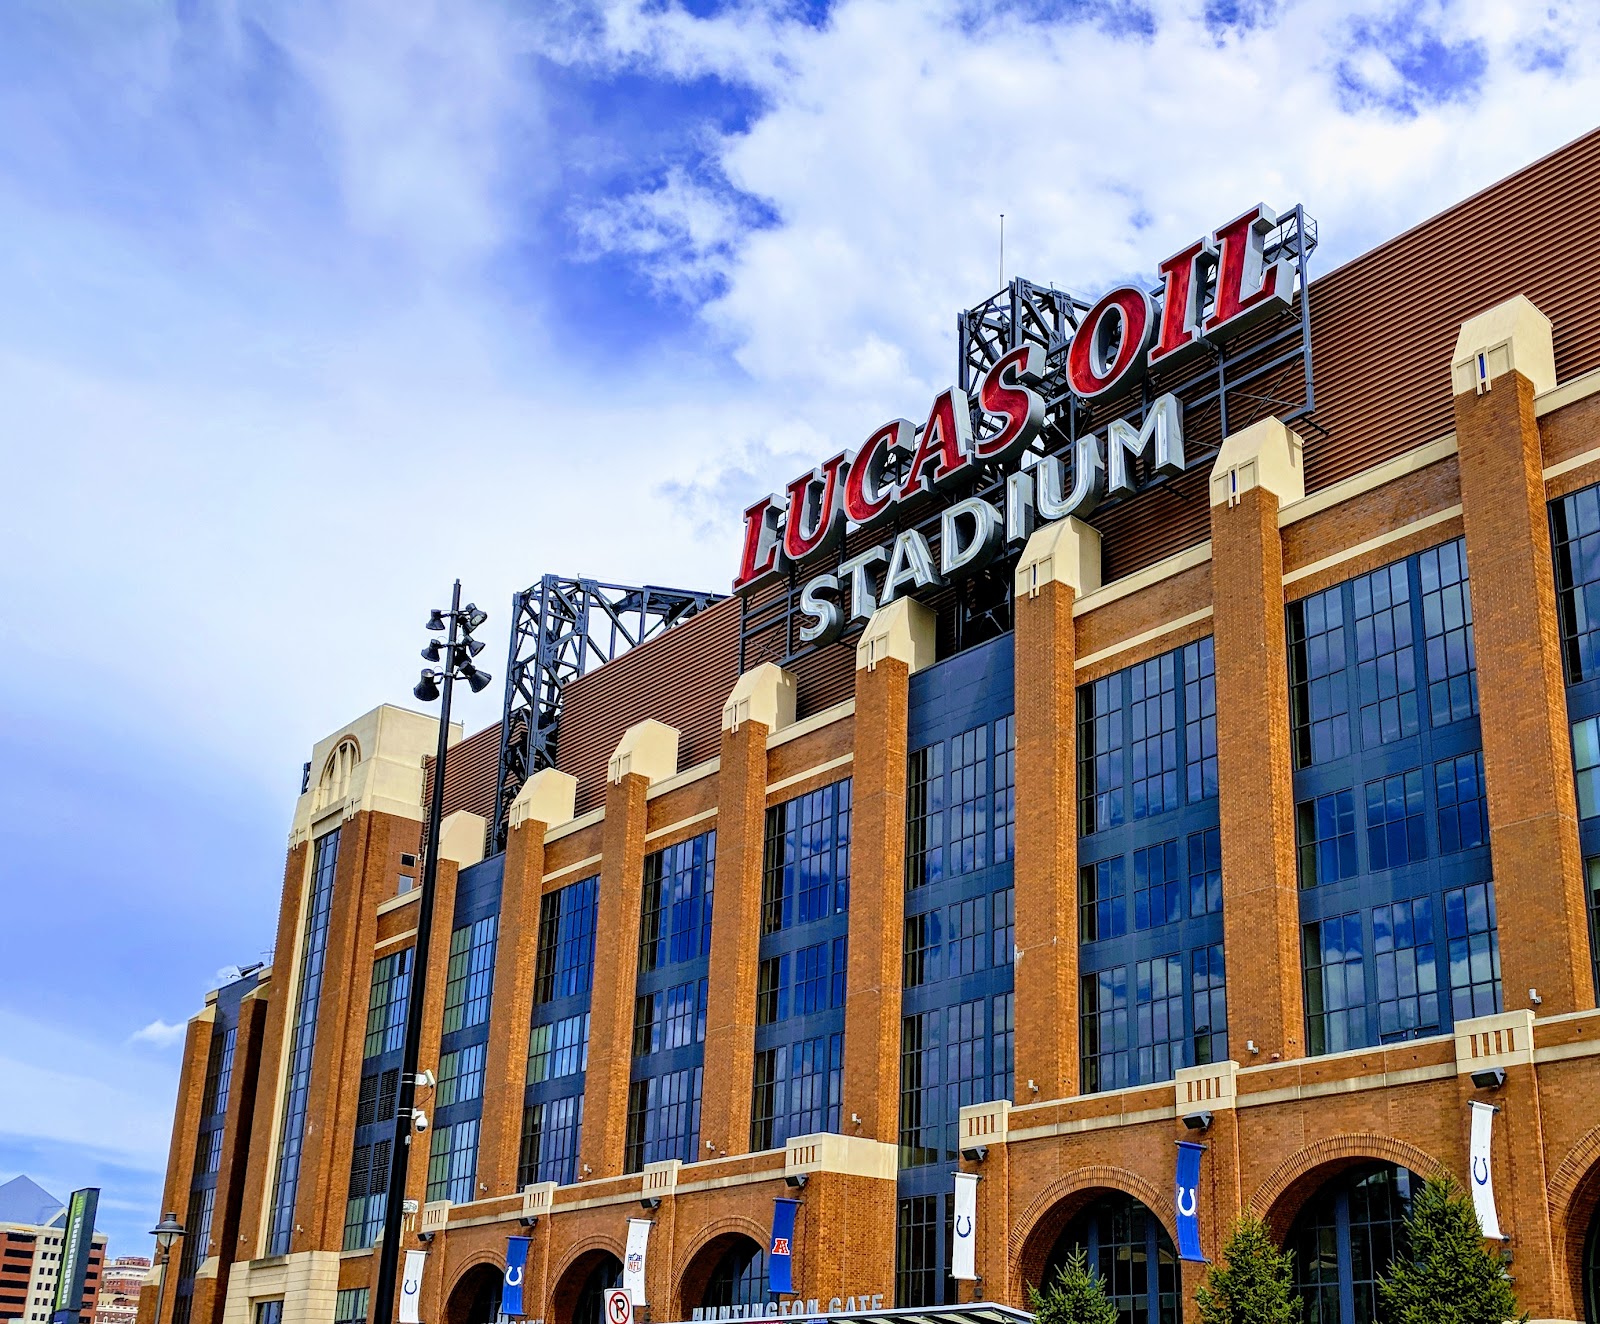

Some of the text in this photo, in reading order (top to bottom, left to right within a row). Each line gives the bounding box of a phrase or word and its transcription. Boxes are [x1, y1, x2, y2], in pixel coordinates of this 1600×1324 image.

[732, 201, 1294, 594] LUCAS OIL
[799, 391, 1186, 646] STADIUM
[61, 1216, 81, 1304] Huntington
[628, 1261, 640, 1271] NFL
[615, 1298, 625, 1319] P
[692, 1294, 884, 1322] HUNTINGTON GATE
